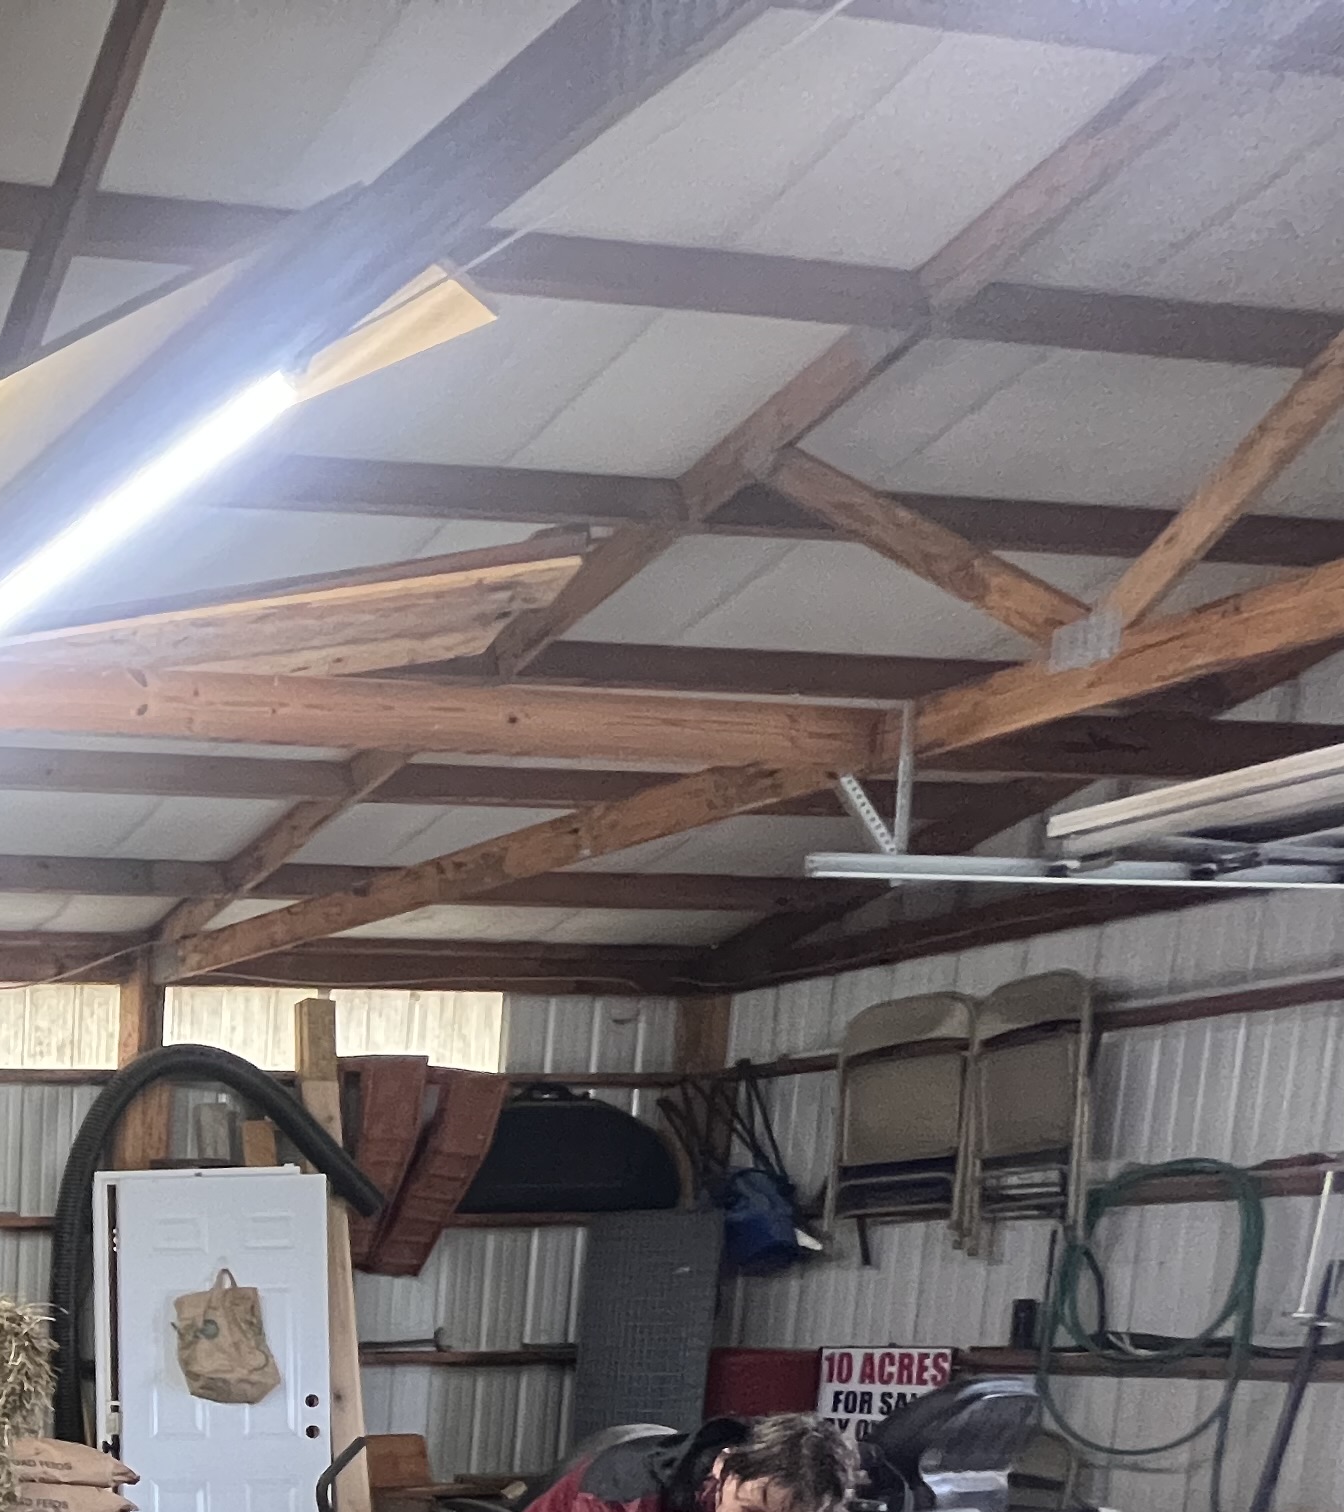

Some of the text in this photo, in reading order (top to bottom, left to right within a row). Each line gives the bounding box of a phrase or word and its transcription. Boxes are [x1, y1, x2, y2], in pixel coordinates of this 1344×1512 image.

[824, 1351, 949, 1387] 10 ACRES
[831, 1390, 920, 1415] FOR SA
